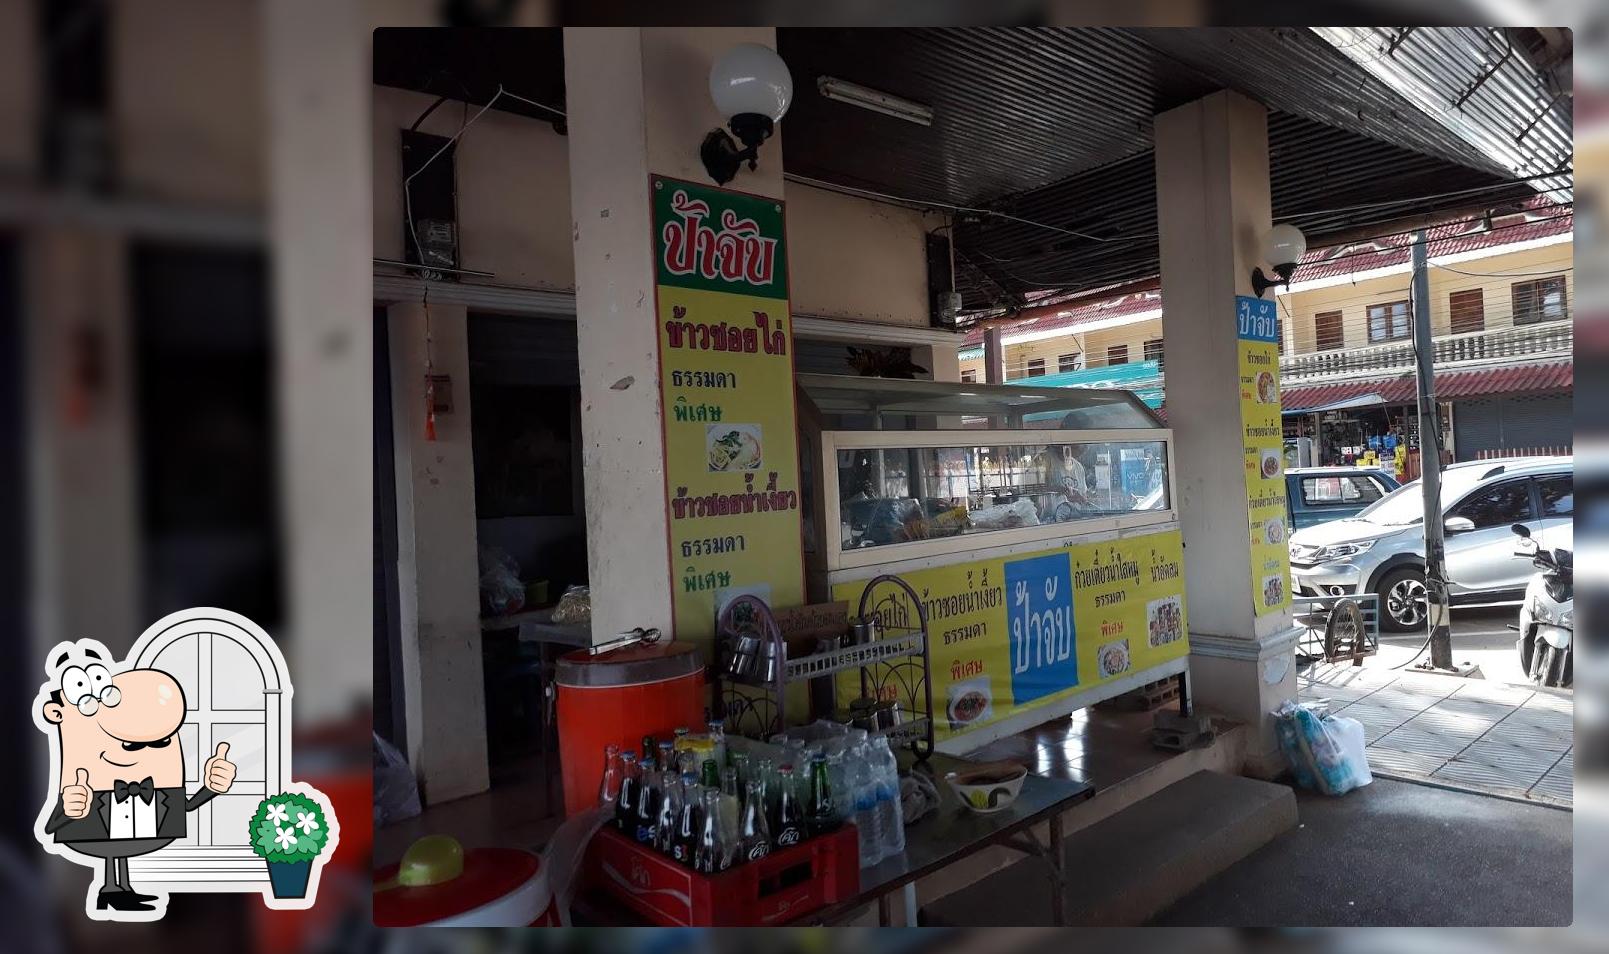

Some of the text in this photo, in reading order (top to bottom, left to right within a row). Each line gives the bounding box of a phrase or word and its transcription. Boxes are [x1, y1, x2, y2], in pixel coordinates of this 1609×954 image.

[666, 306, 786, 356] ข้าวซอยไก่
[672, 370, 736, 389] ธรรมดา
[674, 396, 722, 422] พิเศษ
[672, 472, 797, 520] ข้าวซอยน้ำเงี้ยว
[681, 535, 745, 558] ธรรมดา
[683, 566, 731, 592] พิเศษ
[1095, 590, 1126, 608] ธรรมดา
[943, 622, 987, 645] ธรรมดา
[950, 659, 983, 681] พิเศษ
